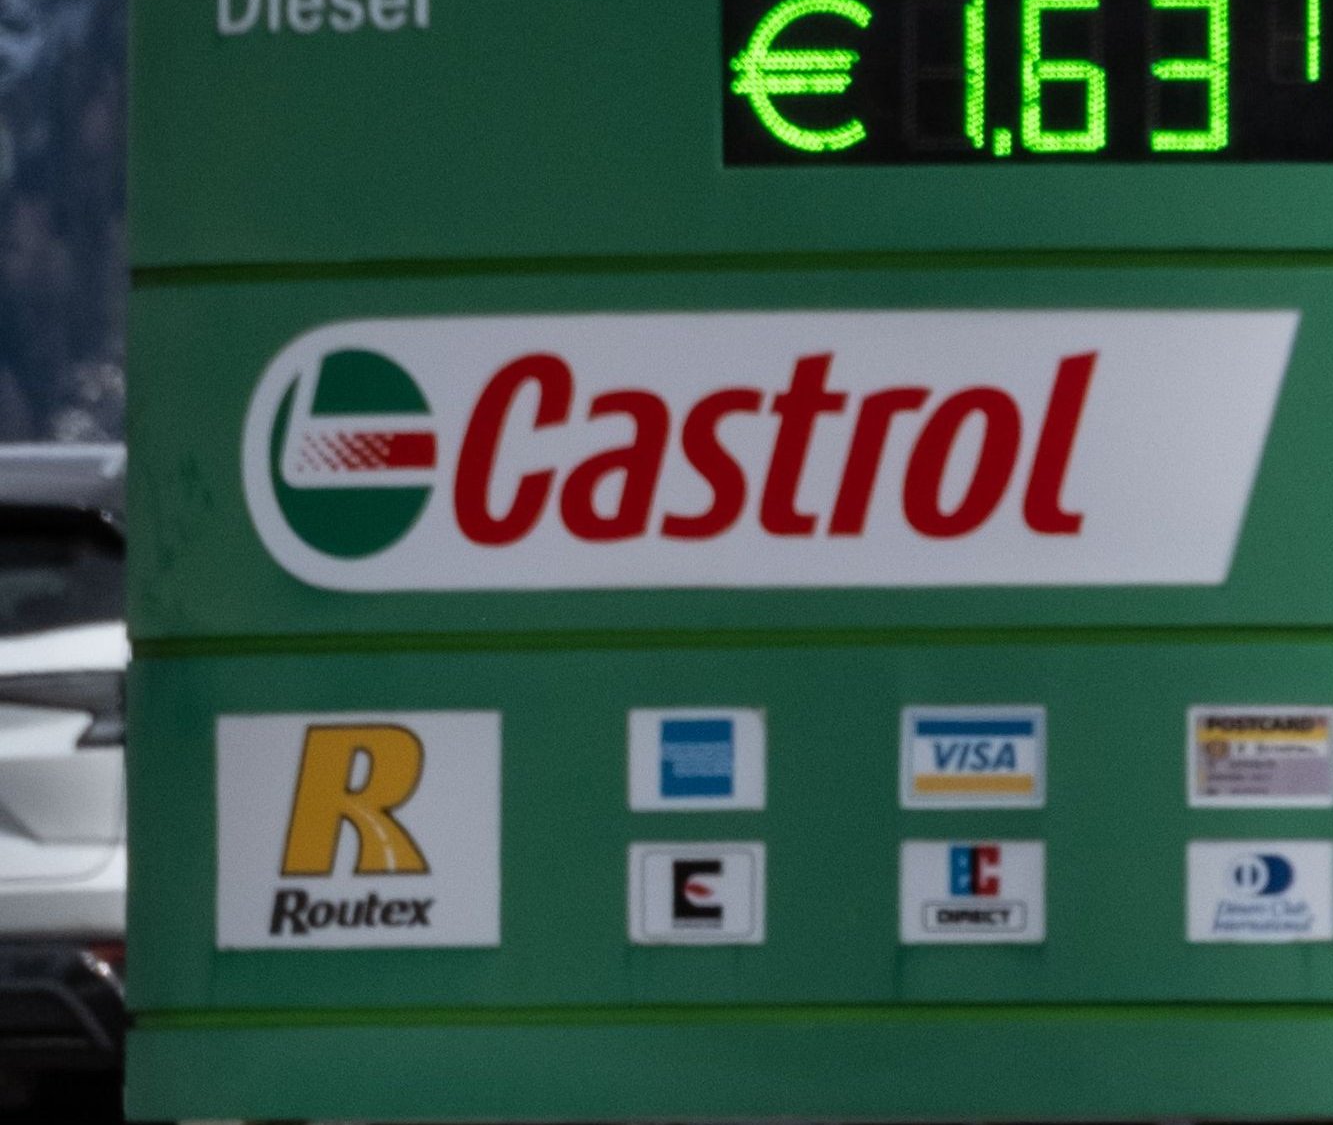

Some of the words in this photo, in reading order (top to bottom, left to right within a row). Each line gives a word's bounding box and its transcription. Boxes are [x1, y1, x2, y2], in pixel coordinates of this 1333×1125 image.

[451, 351, 1099, 548] Castrol
[933, 741, 1018, 772] VISA
[269, 887, 434, 936] Routex
